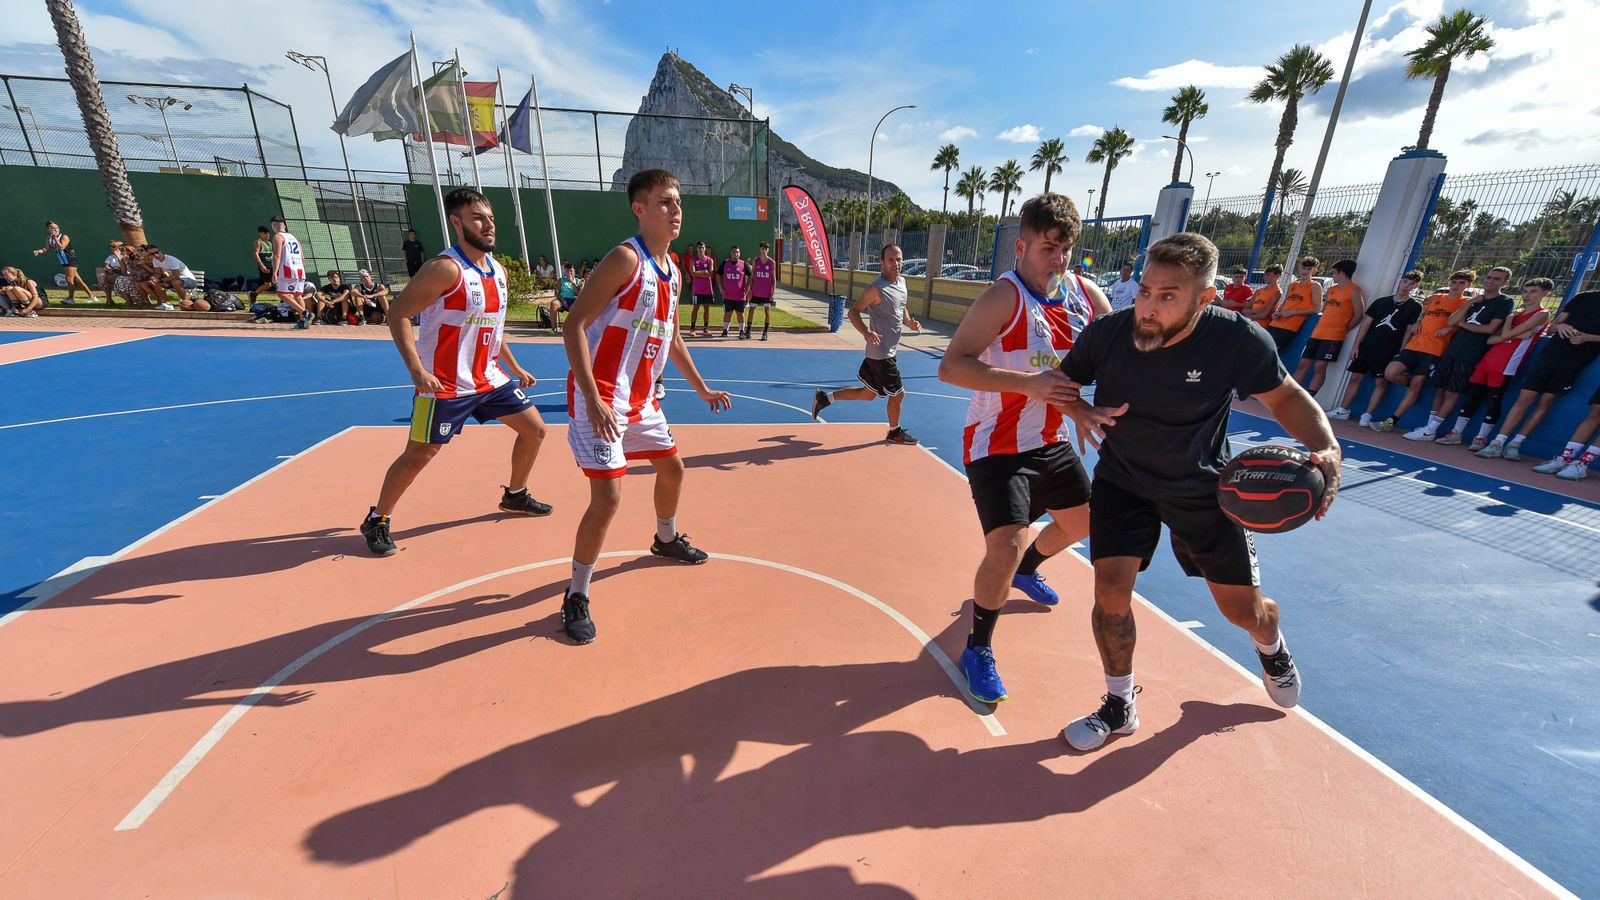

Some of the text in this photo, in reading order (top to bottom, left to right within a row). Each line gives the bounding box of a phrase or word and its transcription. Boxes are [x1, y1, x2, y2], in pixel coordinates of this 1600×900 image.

[288, 241, 300, 255] 12
[482, 332, 491, 346] 0
[643, 342, 660, 359] 55
[1239, 447, 1302, 460] ARMAK
[1228, 468, 1297, 485] XTRATIME
